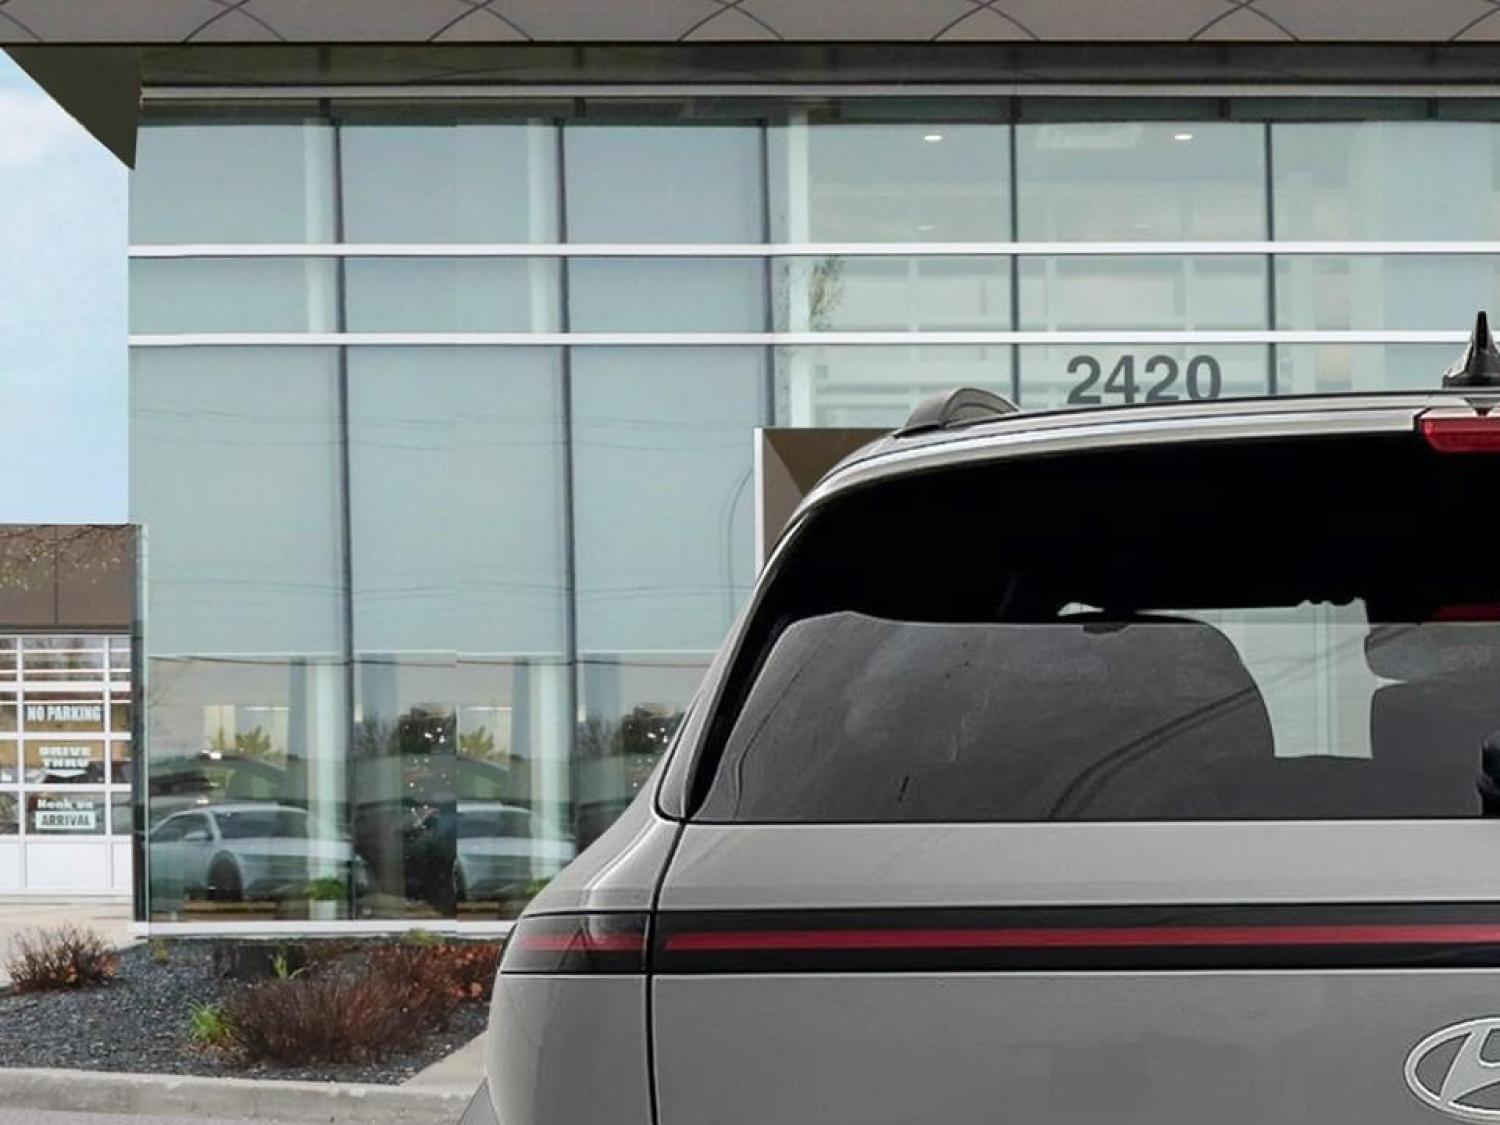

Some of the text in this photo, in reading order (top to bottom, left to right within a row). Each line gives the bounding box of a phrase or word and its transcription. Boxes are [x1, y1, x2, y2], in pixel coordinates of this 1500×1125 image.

[1066, 354, 1222, 404] 2420
[28, 705, 101, 721] NO PARKING
[42, 813, 91, 826] ARRIVAL
